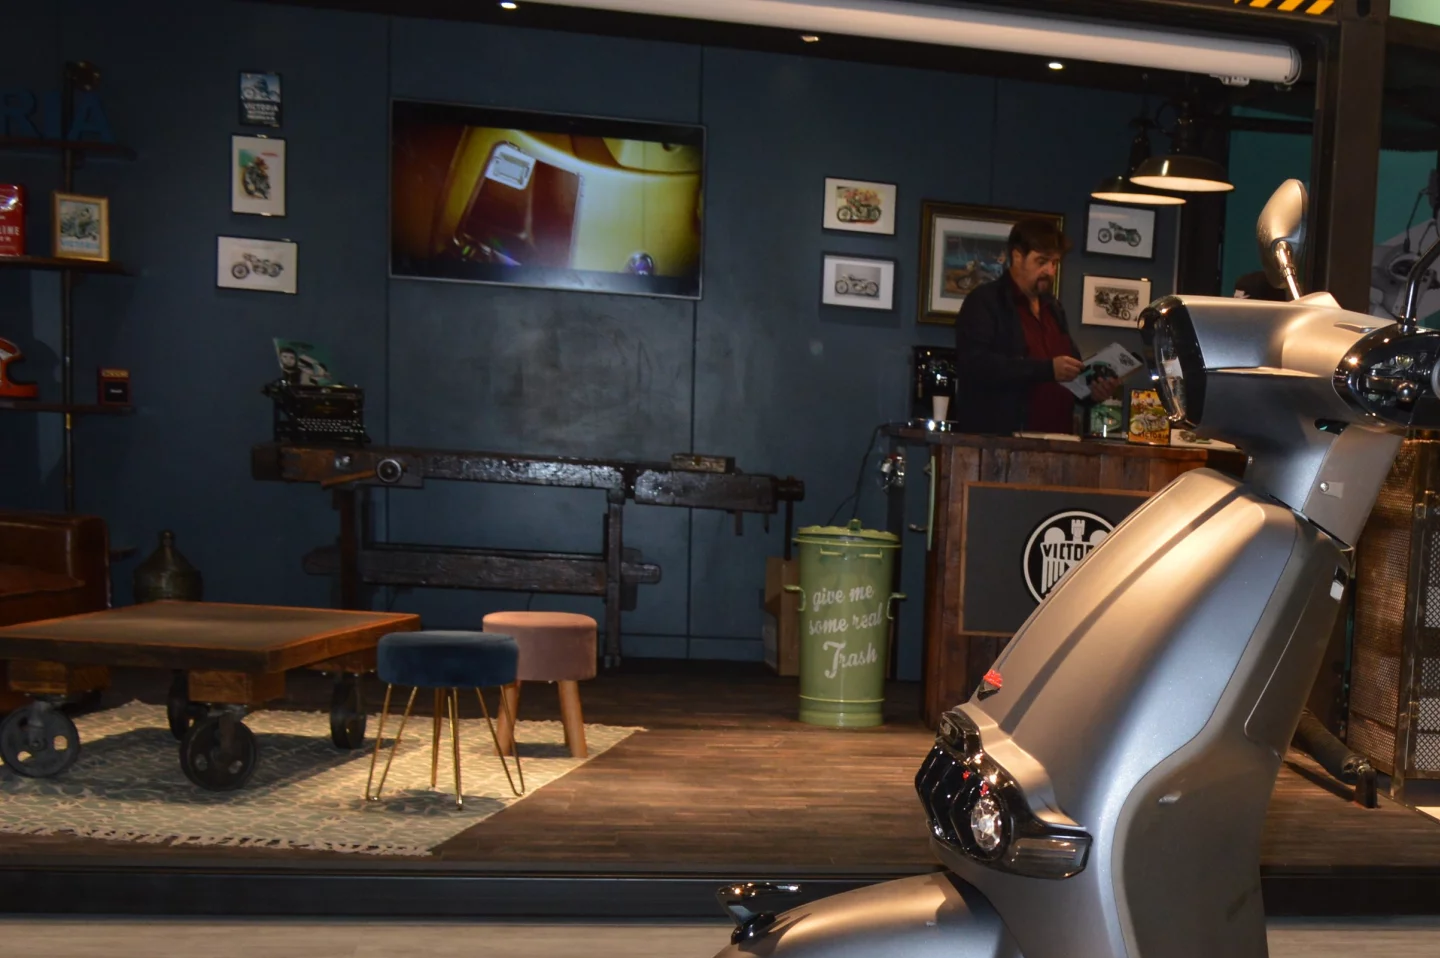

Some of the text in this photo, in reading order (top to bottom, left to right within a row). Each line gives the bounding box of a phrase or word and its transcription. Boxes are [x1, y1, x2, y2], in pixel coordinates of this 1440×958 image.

[812, 585, 875, 612] give me
[808, 605, 883, 636] some real
[823, 640, 878, 680] Trash
